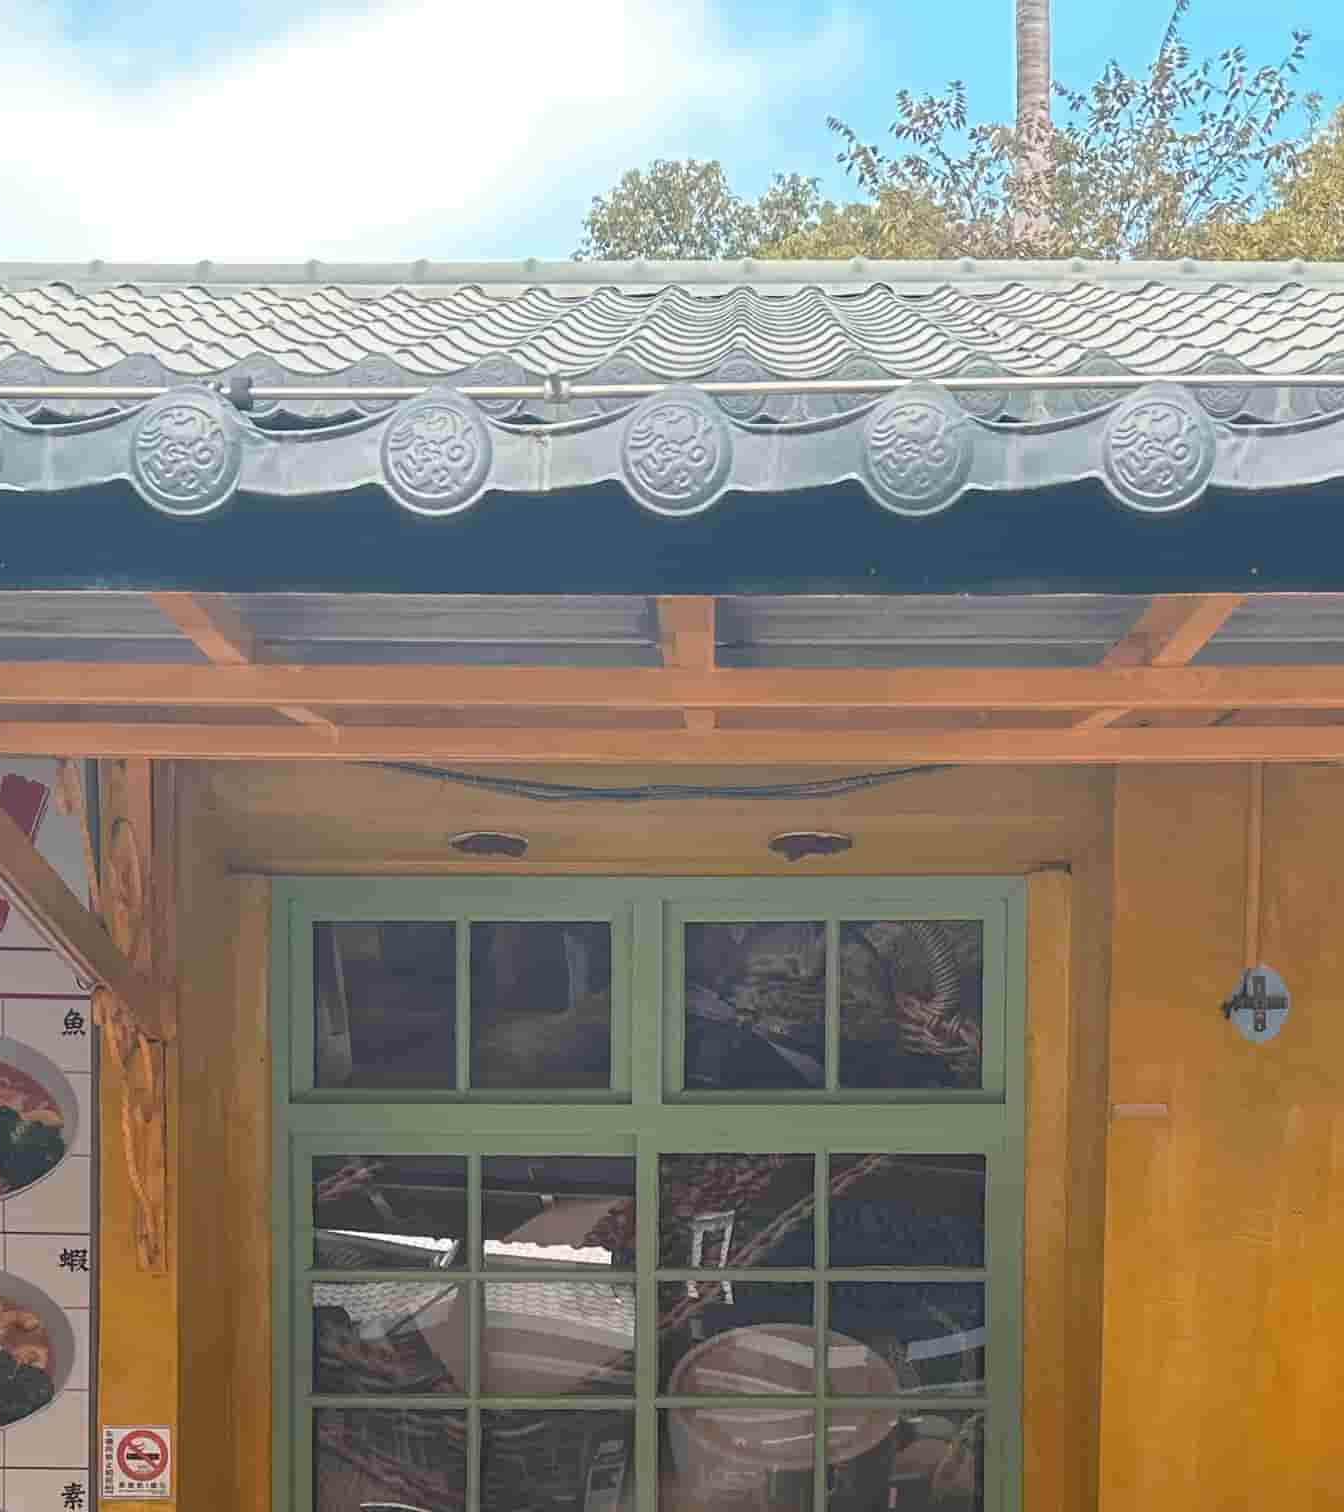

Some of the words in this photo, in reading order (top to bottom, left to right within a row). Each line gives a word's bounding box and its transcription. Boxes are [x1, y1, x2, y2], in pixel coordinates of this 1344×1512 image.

[62, 1008, 88, 1037] 魚
[58, 1247, 90, 1274] 蝦
[61, 1481, 87, 1511] 素
